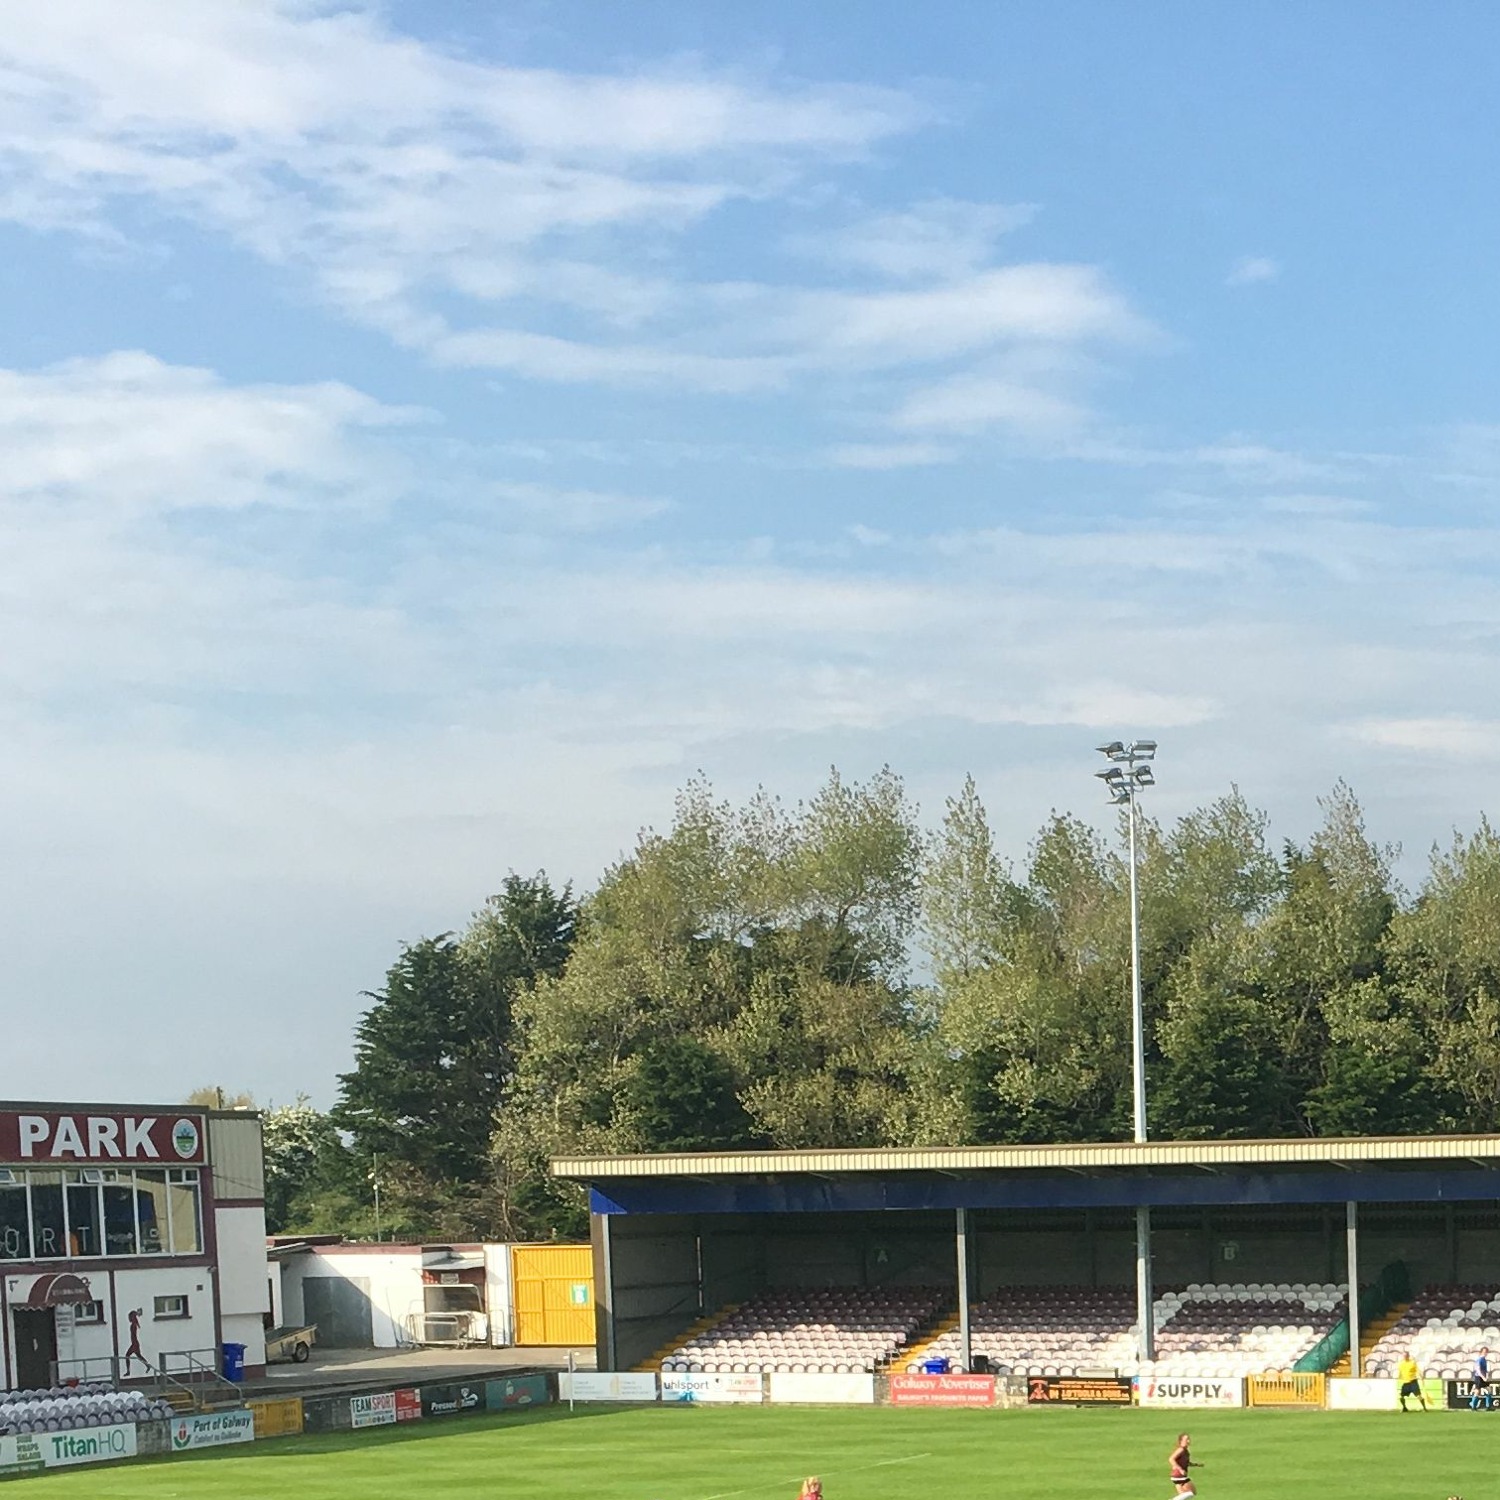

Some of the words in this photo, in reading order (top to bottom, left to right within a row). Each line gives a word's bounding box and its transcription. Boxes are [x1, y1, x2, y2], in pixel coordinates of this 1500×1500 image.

[18, 1115, 160, 1157] PARK
[876, 1248, 889, 1262] A
[1223, 1245, 1236, 1260] B
[663, 1379, 709, 1391] uhlsport
[893, 1376, 936, 1390] Galway
[938, 1376, 990, 1390] Advertiser
[193, 1420, 211, 1432] Port
[212, 1418, 221, 1430] of
[222, 1415, 251, 1429] Galway
[52, 1429, 126, 1459] TitanHQ
